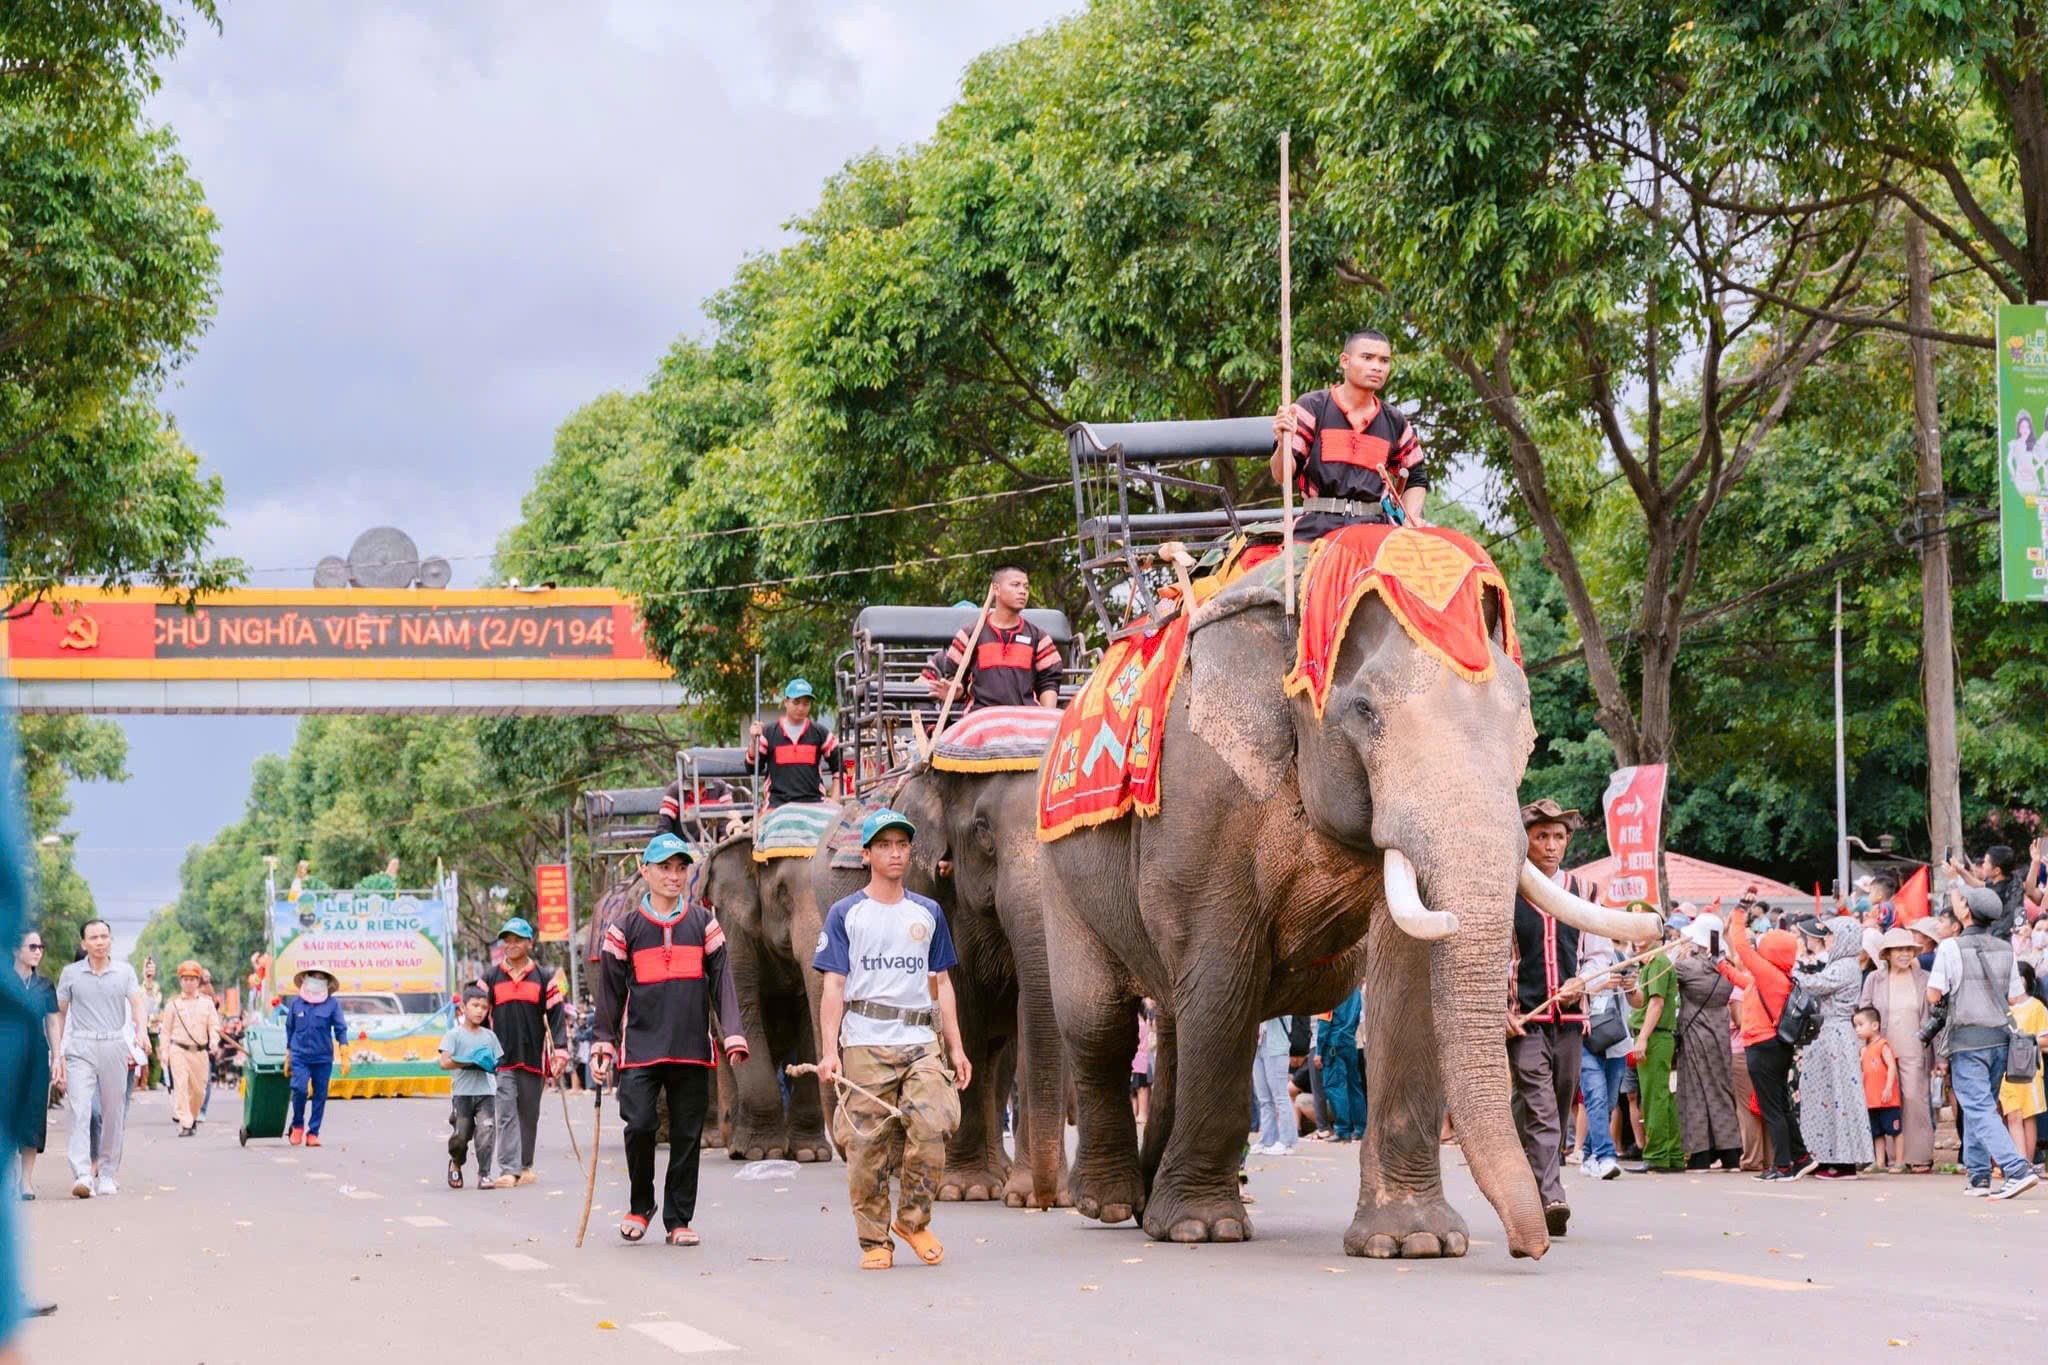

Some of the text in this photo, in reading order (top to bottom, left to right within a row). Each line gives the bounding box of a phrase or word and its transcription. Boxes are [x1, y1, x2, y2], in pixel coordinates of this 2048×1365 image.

[218, 612, 318, 646] NGHĨA
[323, 612, 393, 650] VIỆT
[399, 617, 470, 646] NAM
[860, 953, 924, 974] trivago
